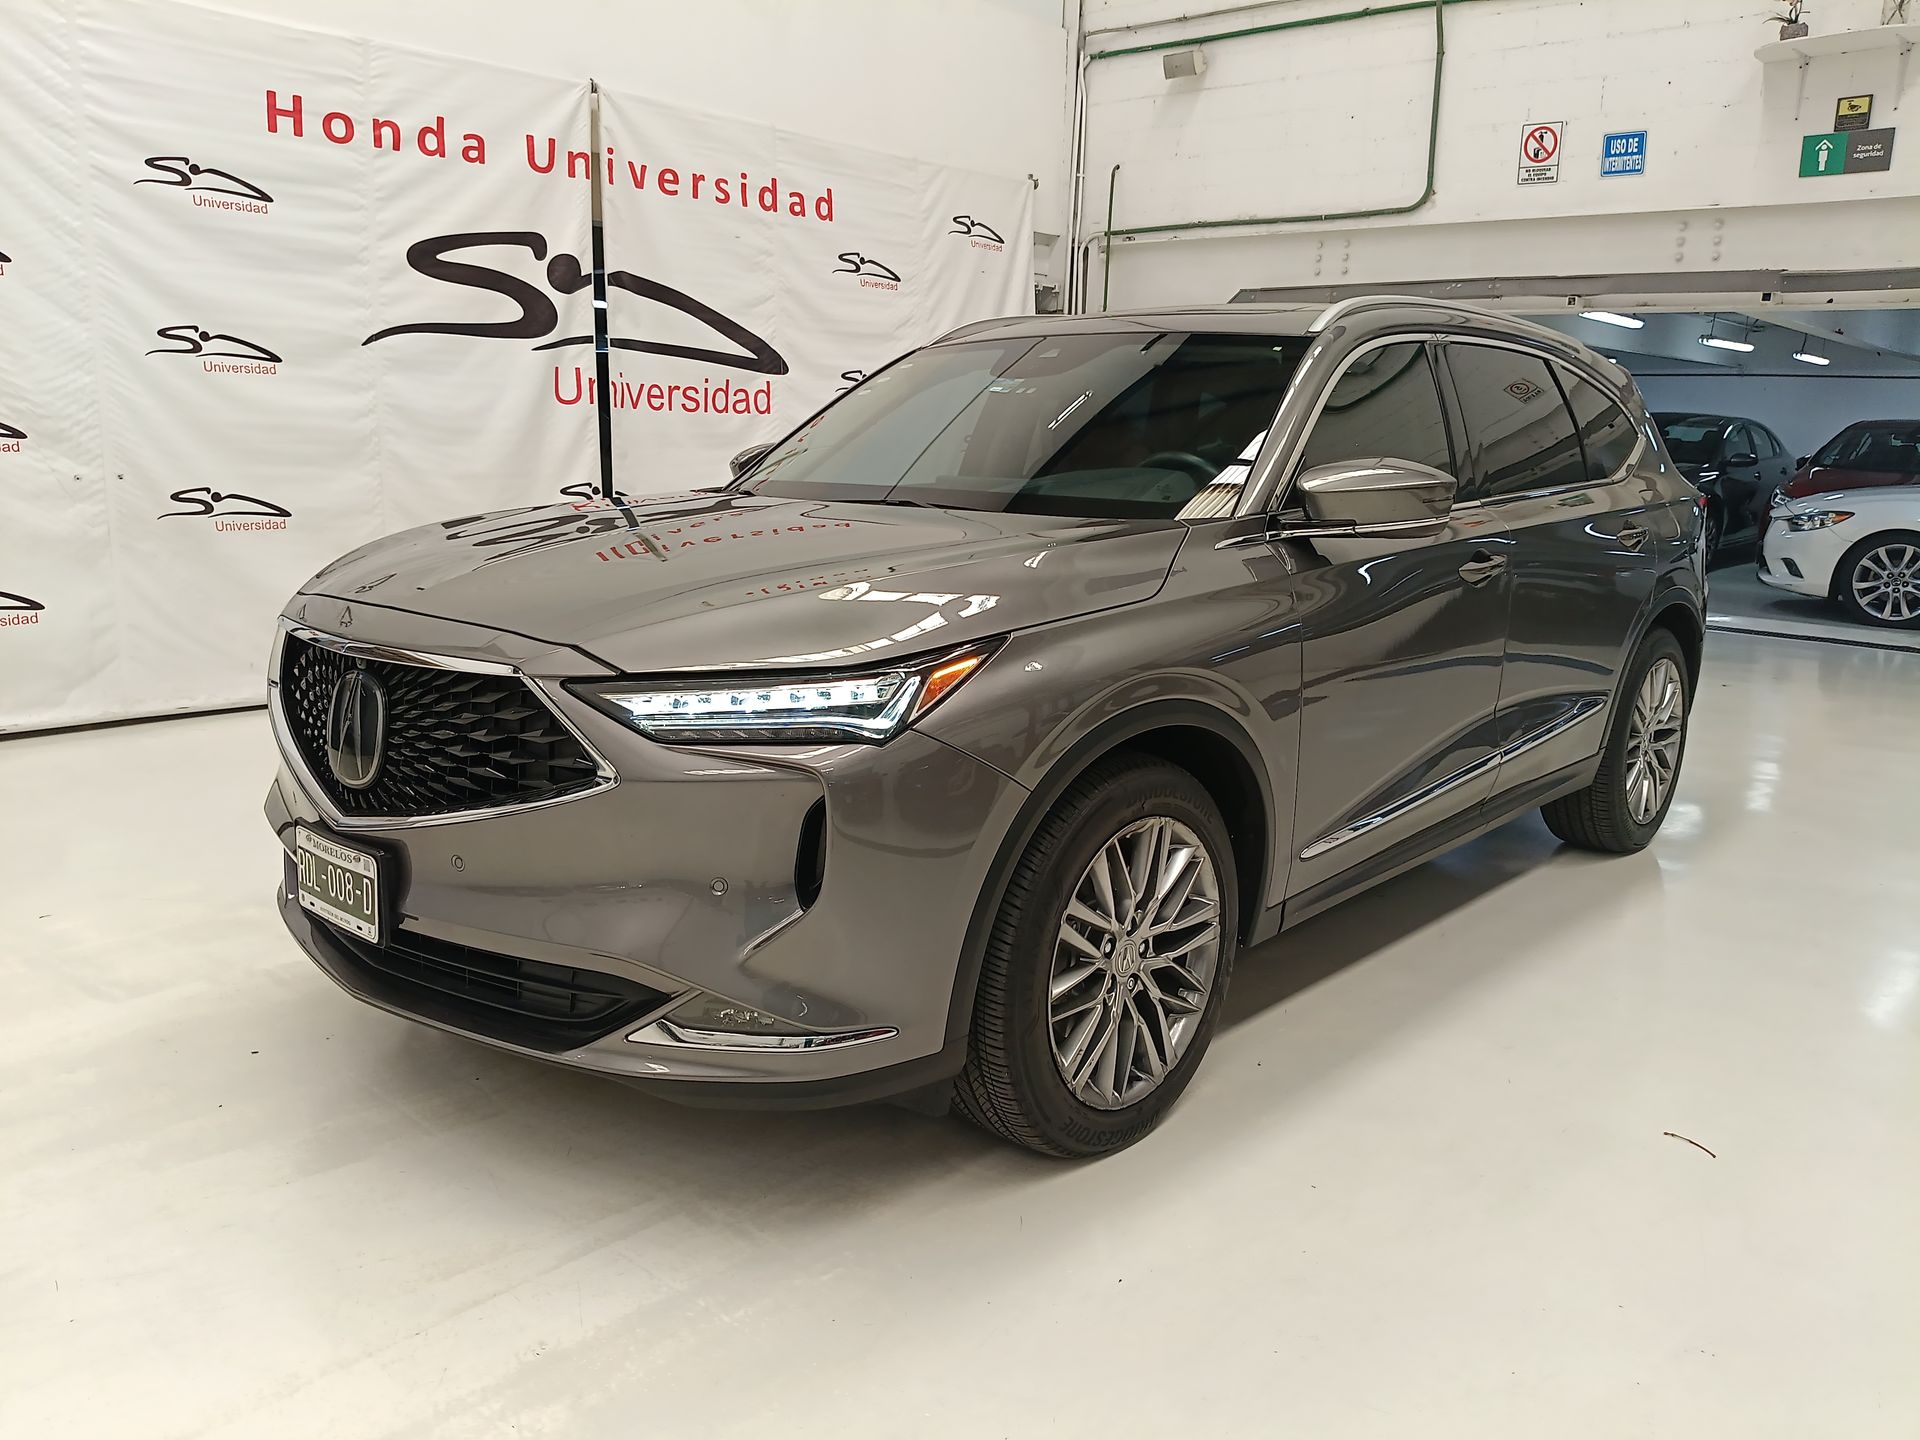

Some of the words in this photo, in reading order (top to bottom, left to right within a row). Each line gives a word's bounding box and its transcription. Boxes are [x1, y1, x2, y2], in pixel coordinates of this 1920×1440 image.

[1611, 139, 1627, 154] USO
[1627, 137, 1639, 153] DE
[266, 90, 486, 165] Honda
[526, 134, 834, 221] Universidad
[1853, 150, 1884, 158] seguridad
[193, 194, 269, 215] Universidad
[971, 240, 1002, 252] Universidad
[860, 279, 898, 291] Universidad
[203, 360, 277, 376] Universidad
[215, 519, 287, 532] Universidad
[312, 840, 353, 863] MORELOS
